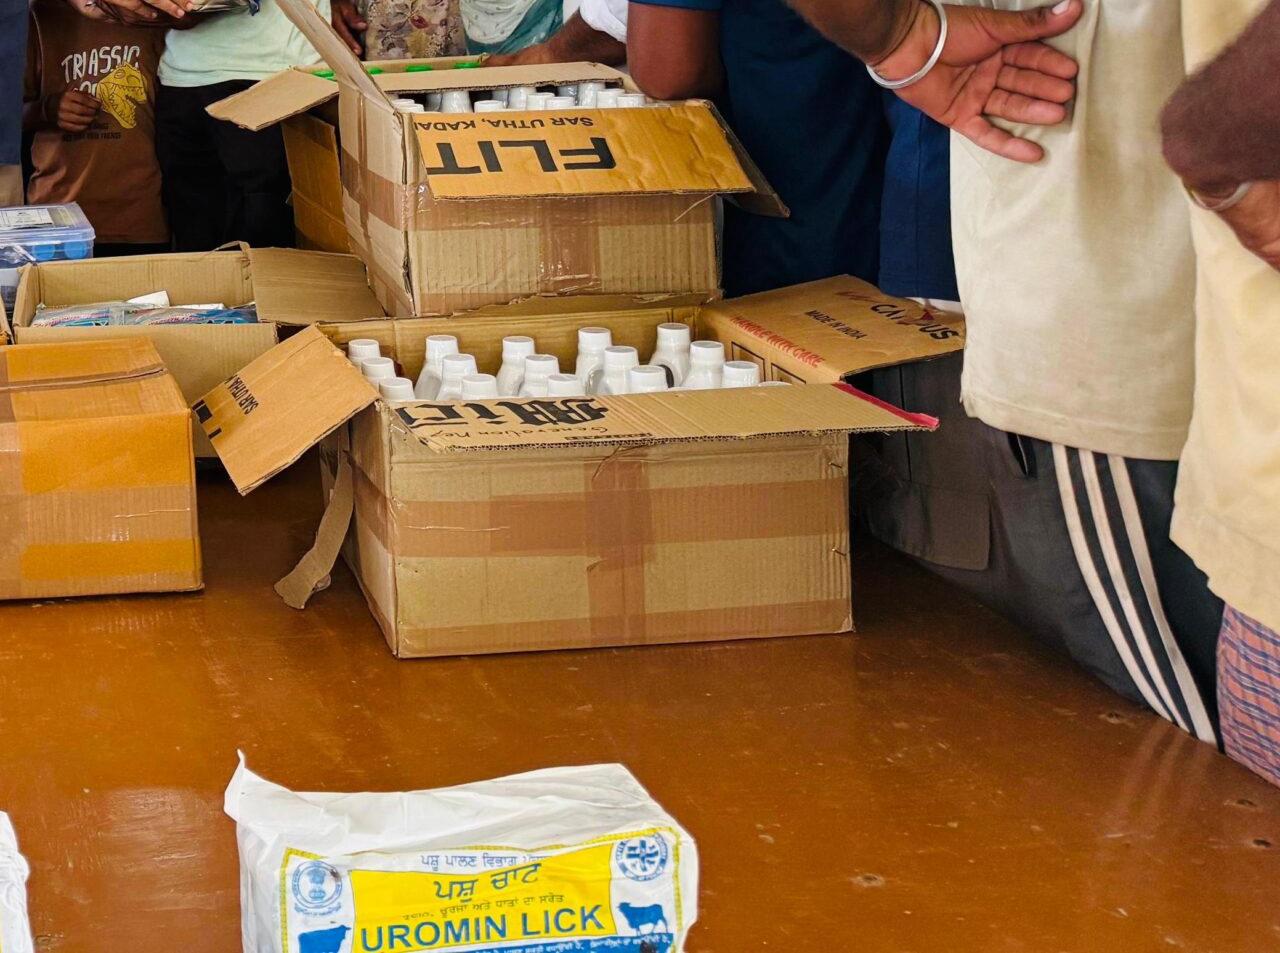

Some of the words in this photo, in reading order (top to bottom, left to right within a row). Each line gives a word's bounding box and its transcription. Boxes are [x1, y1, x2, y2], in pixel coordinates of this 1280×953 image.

[61, 45, 141, 84] TRIASSIC
[482, 118, 545, 130] UTHA,
[550, 117, 593, 127] SAR
[426, 137, 616, 175] FLIT
[804, 309, 834, 326] MADE
[831, 321, 842, 329] IN
[840, 323, 867, 340] INDIA
[731, 314, 770, 340] HANDLE
[767, 330, 793, 351] WITH
[791, 345, 826, 368] CARE
[239, 393, 259, 416] SAR
[476, 425, 609, 439] Generation
[490, 863, 542, 890] ਚਾਟ
[361, 913, 506, 952] UROMIN
[521, 904, 605, 936] LICK
